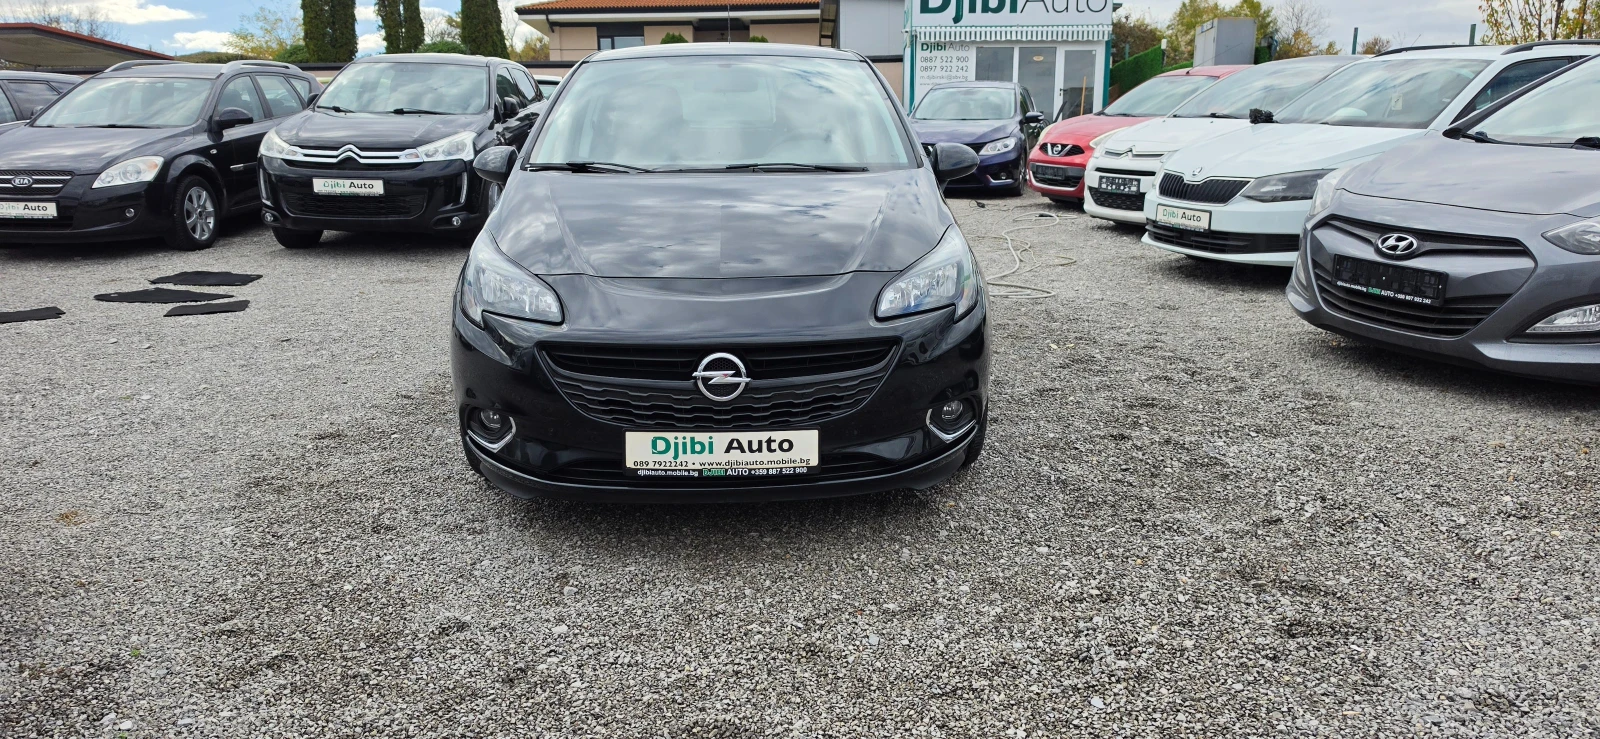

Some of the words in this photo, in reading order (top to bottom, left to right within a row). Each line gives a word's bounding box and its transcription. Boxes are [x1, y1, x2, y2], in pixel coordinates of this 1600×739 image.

[920, 42, 946, 53] Djibi
[947, 42, 970, 52] Auto
[920, 55, 937, 63] 0887
[940, 55, 954, 63] 522
[955, 55, 969, 63] 900
[919, 65, 937, 73] 0897
[939, 65, 953, 73] 922
[955, 65, 969, 73] 242
[348, 181, 374, 189] Auto
[23, 203, 48, 211] Auto
[1181, 211, 1202, 222] Auto
[651, 435, 714, 460] Djibi
[724, 435, 794, 454] Auto
[633, 460, 650, 468] 089
[653, 460, 689, 468] 7922242
[699, 457, 811, 469] www.djibiauto.mobile.bg
[727, 468, 749, 476] AUTO
[751, 468, 767, 476] +359
[782, 467, 794, 475] 522
